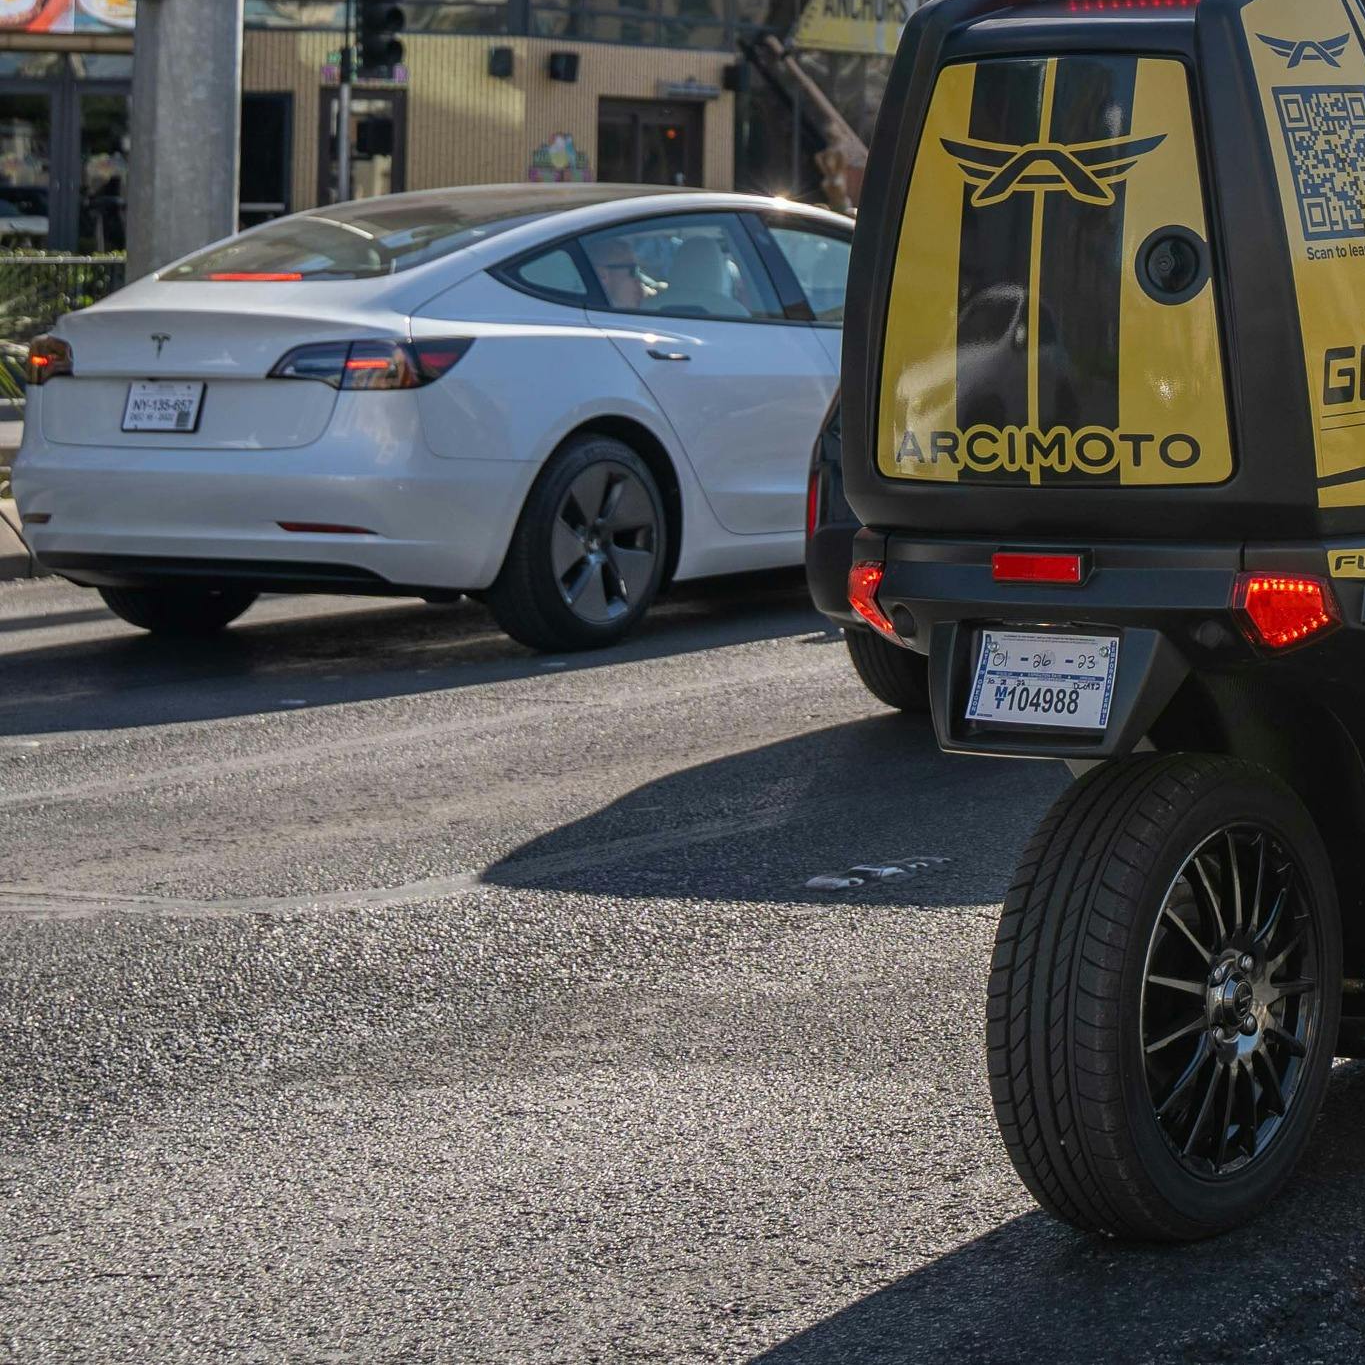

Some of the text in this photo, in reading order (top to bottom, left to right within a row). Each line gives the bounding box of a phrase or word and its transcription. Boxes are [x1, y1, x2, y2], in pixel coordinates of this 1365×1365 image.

[1306, 246, 1335, 261] Scan
[1335, 245, 1347, 258] to
[895, 429, 1202, 469] ARCIMOTO
[992, 650, 1008, 667] 01
[1032, 652, 1052, 669] 26
[1077, 654, 1096, 670] 23
[1007, 686, 1080, 715] 104988
